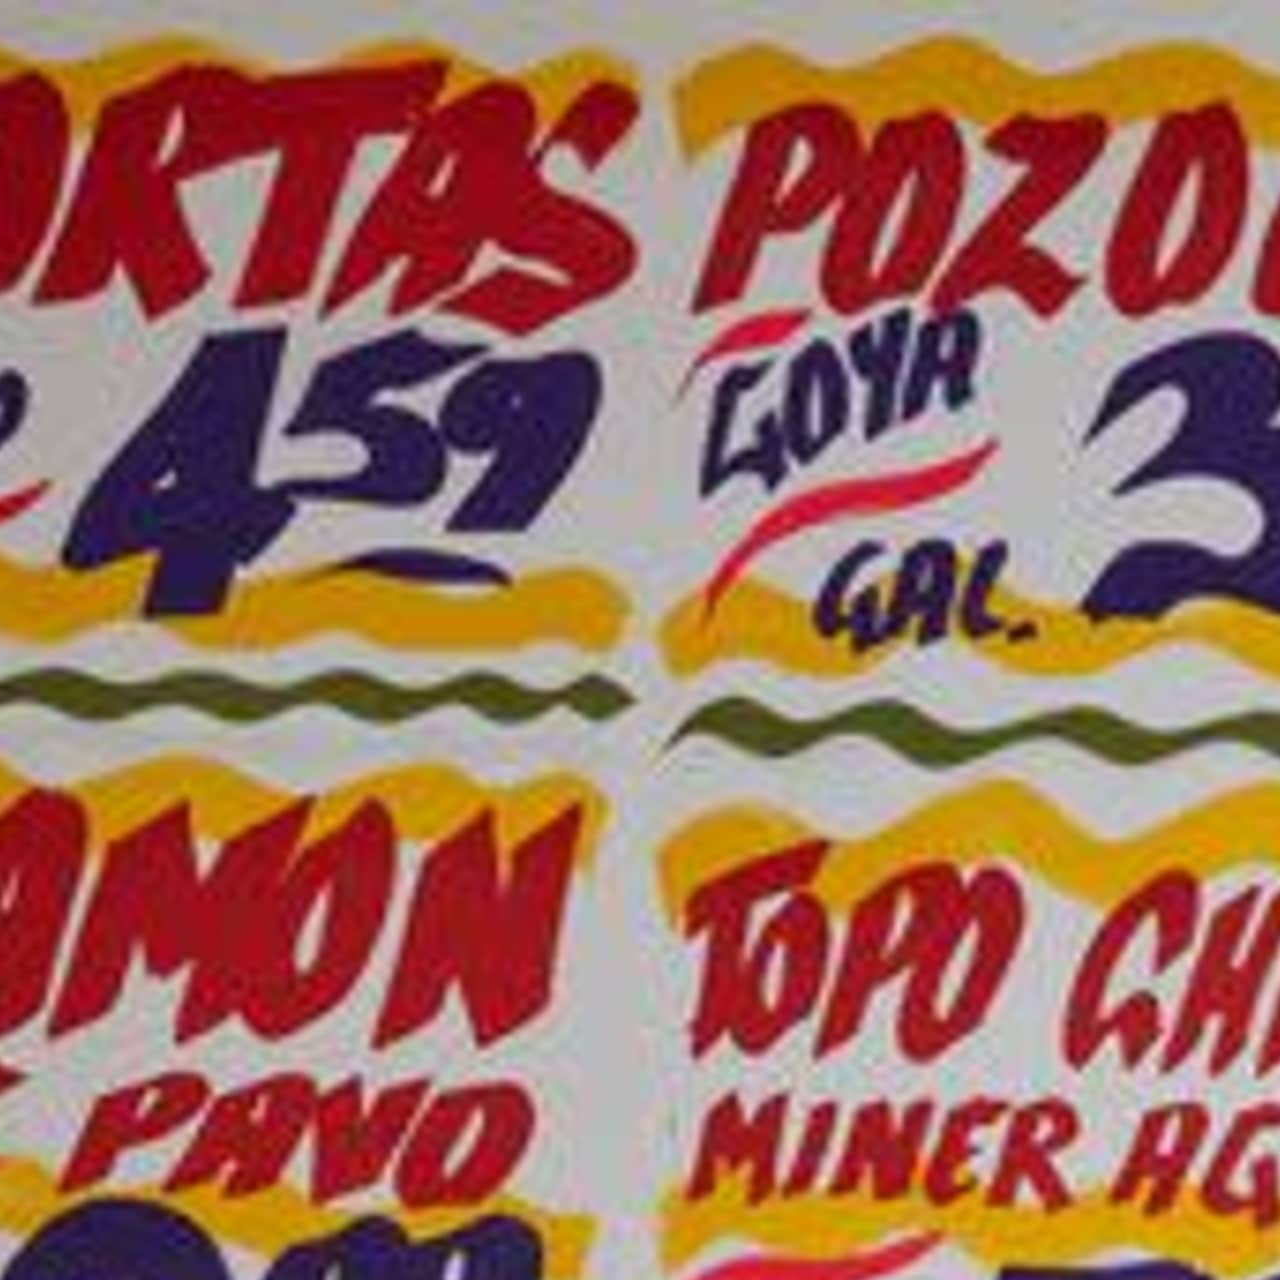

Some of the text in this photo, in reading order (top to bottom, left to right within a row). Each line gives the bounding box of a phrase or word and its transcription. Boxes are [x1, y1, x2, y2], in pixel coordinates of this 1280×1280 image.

[700, 305, 980, 497] GOYA
[811, 540, 1038, 653] GAL.
[683, 839, 1028, 1062] TOPO
[58, 1072, 538, 1212] PAVO
[684, 1088, 1086, 1212] MINER
